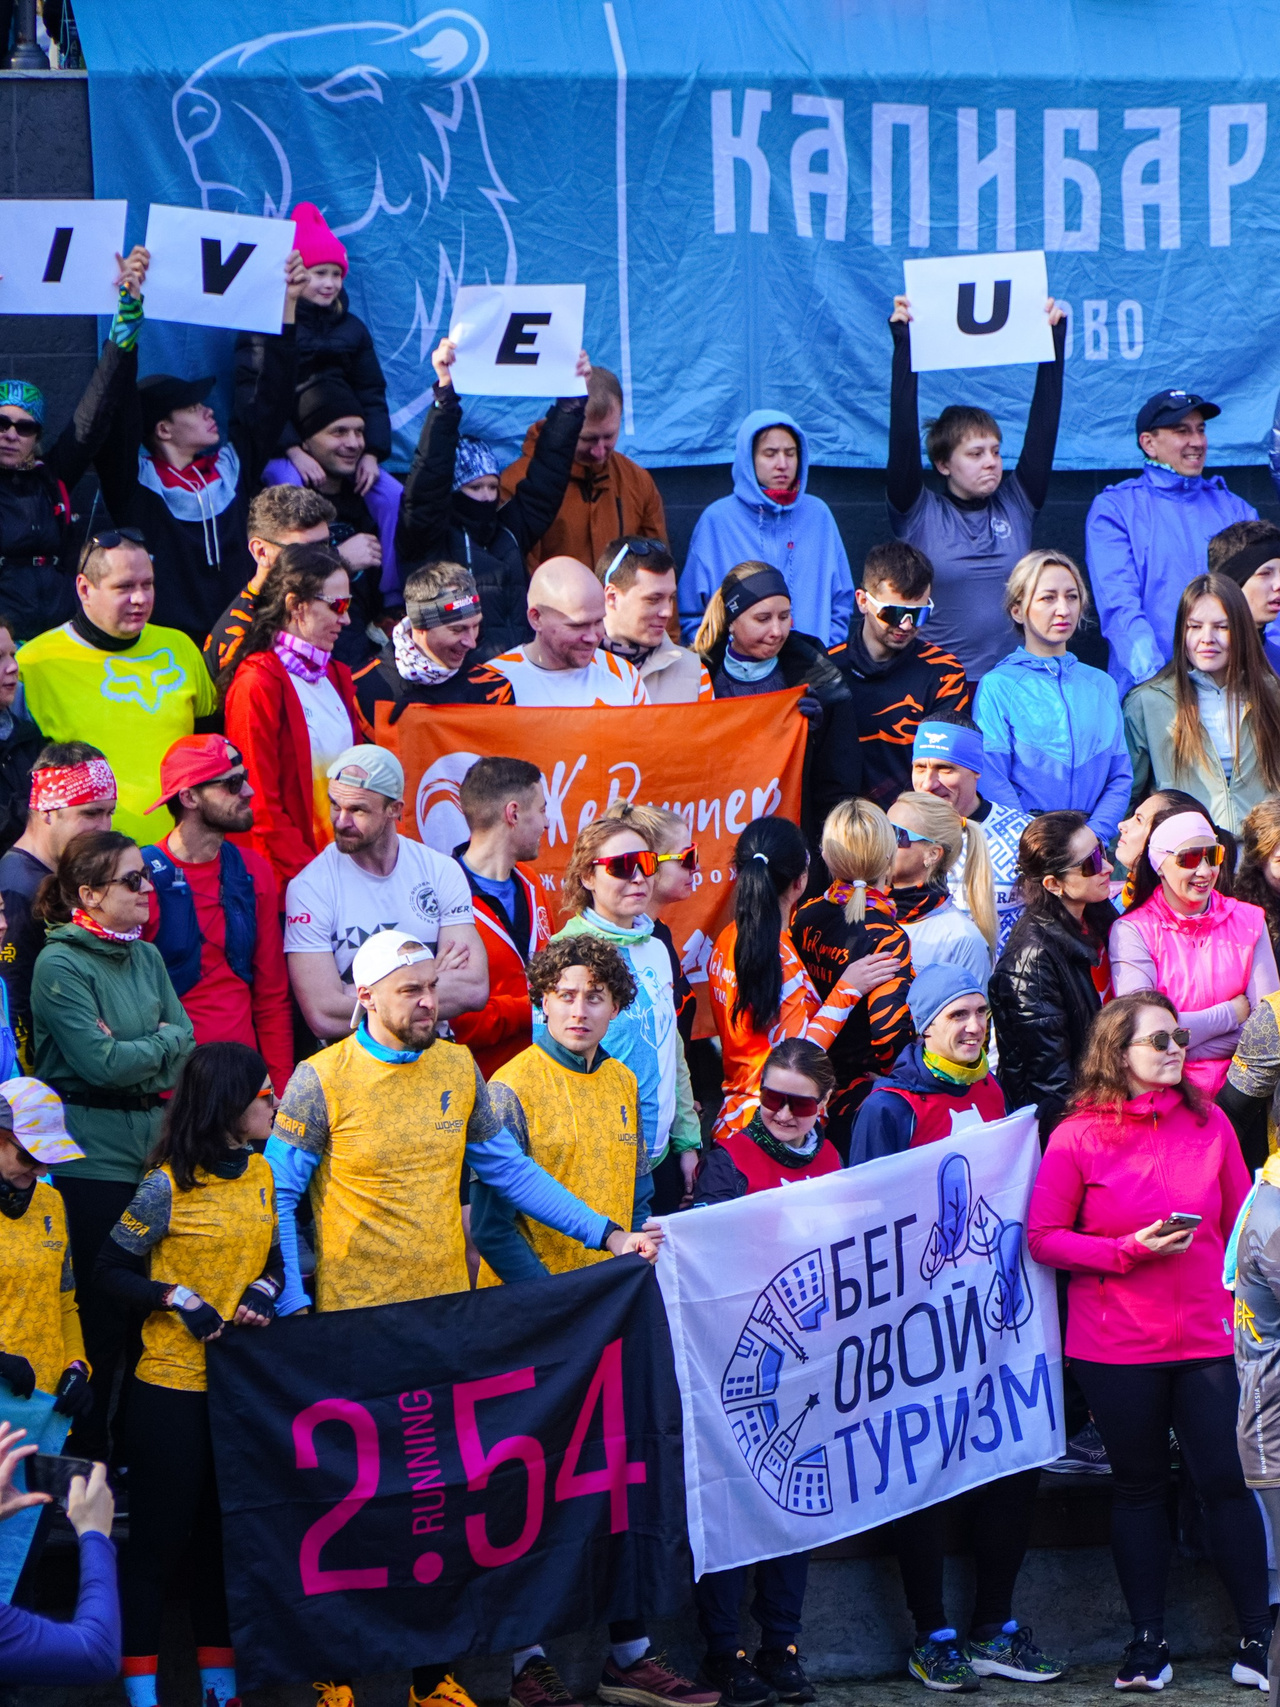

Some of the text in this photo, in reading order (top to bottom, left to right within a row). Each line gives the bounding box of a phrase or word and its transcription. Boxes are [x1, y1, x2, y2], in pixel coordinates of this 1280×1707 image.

[41, 227, 72, 283] I
[200, 238, 257, 295] V
[495, 312, 552, 366] E
[956, 279, 1012, 335] U
[831, 1214, 917, 1322] БЕГ
[834, 1281, 987, 1413] ОВОЙ
[399, 1389, 447, 1536] RUNNING
[834, 1353, 1057, 1505] ТУРИЗМ
